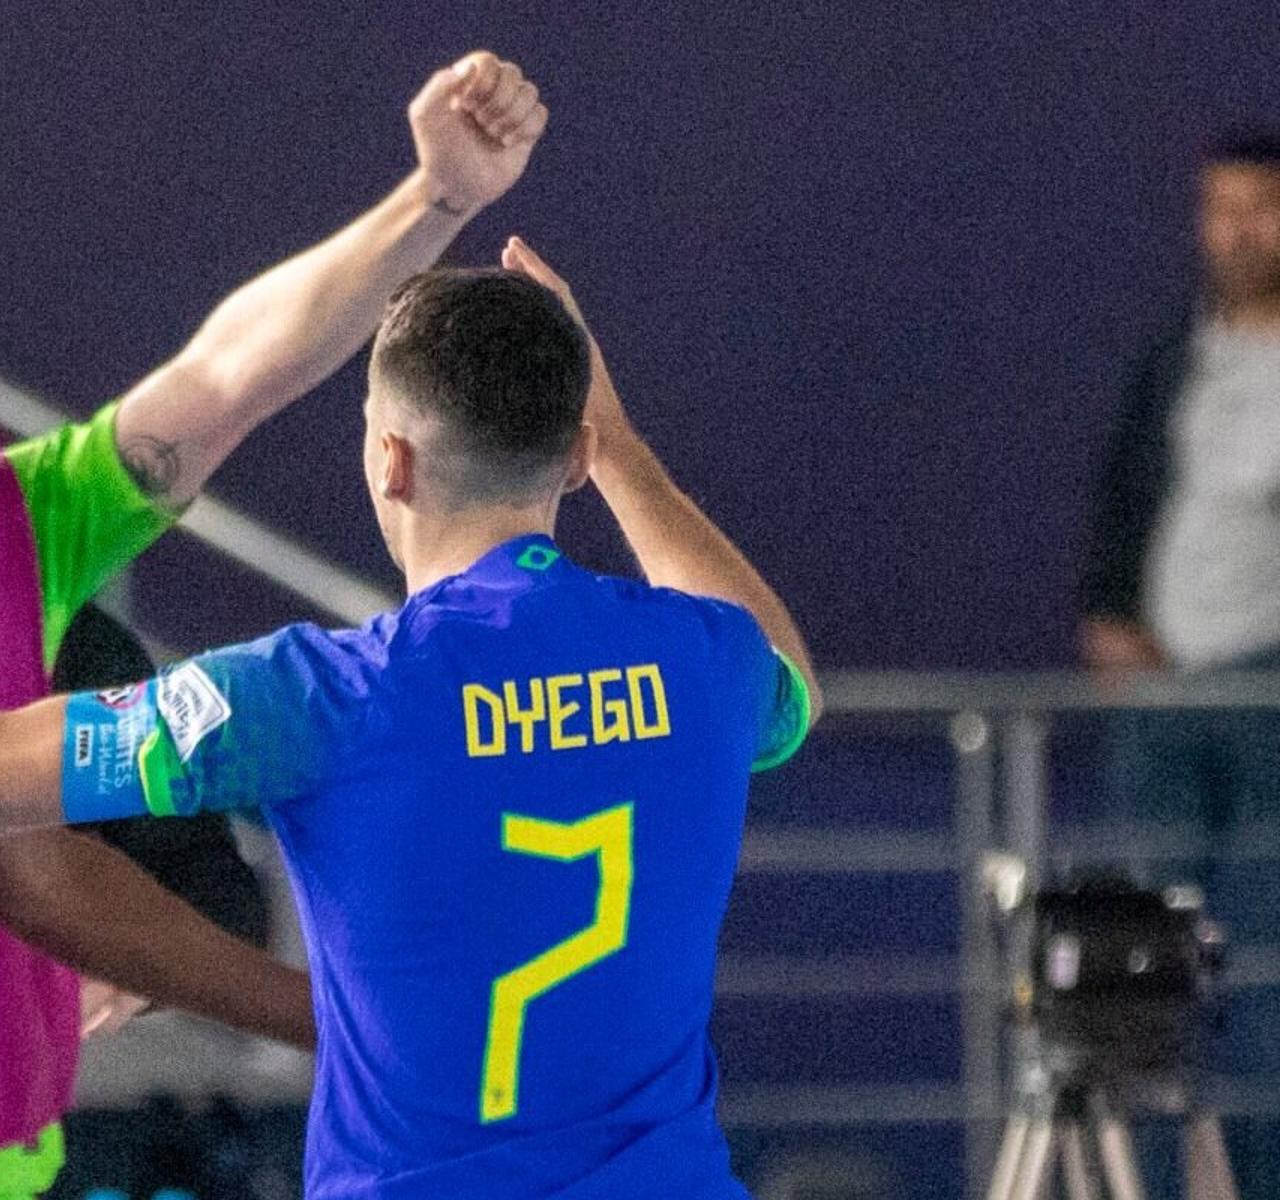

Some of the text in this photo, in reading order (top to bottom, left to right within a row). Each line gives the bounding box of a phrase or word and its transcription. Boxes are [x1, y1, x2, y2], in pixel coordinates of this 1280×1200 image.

[79, 729, 90, 761] FIFA
[463, 663, 671, 758] DYEGO
[479, 800, 634, 1125] 7
